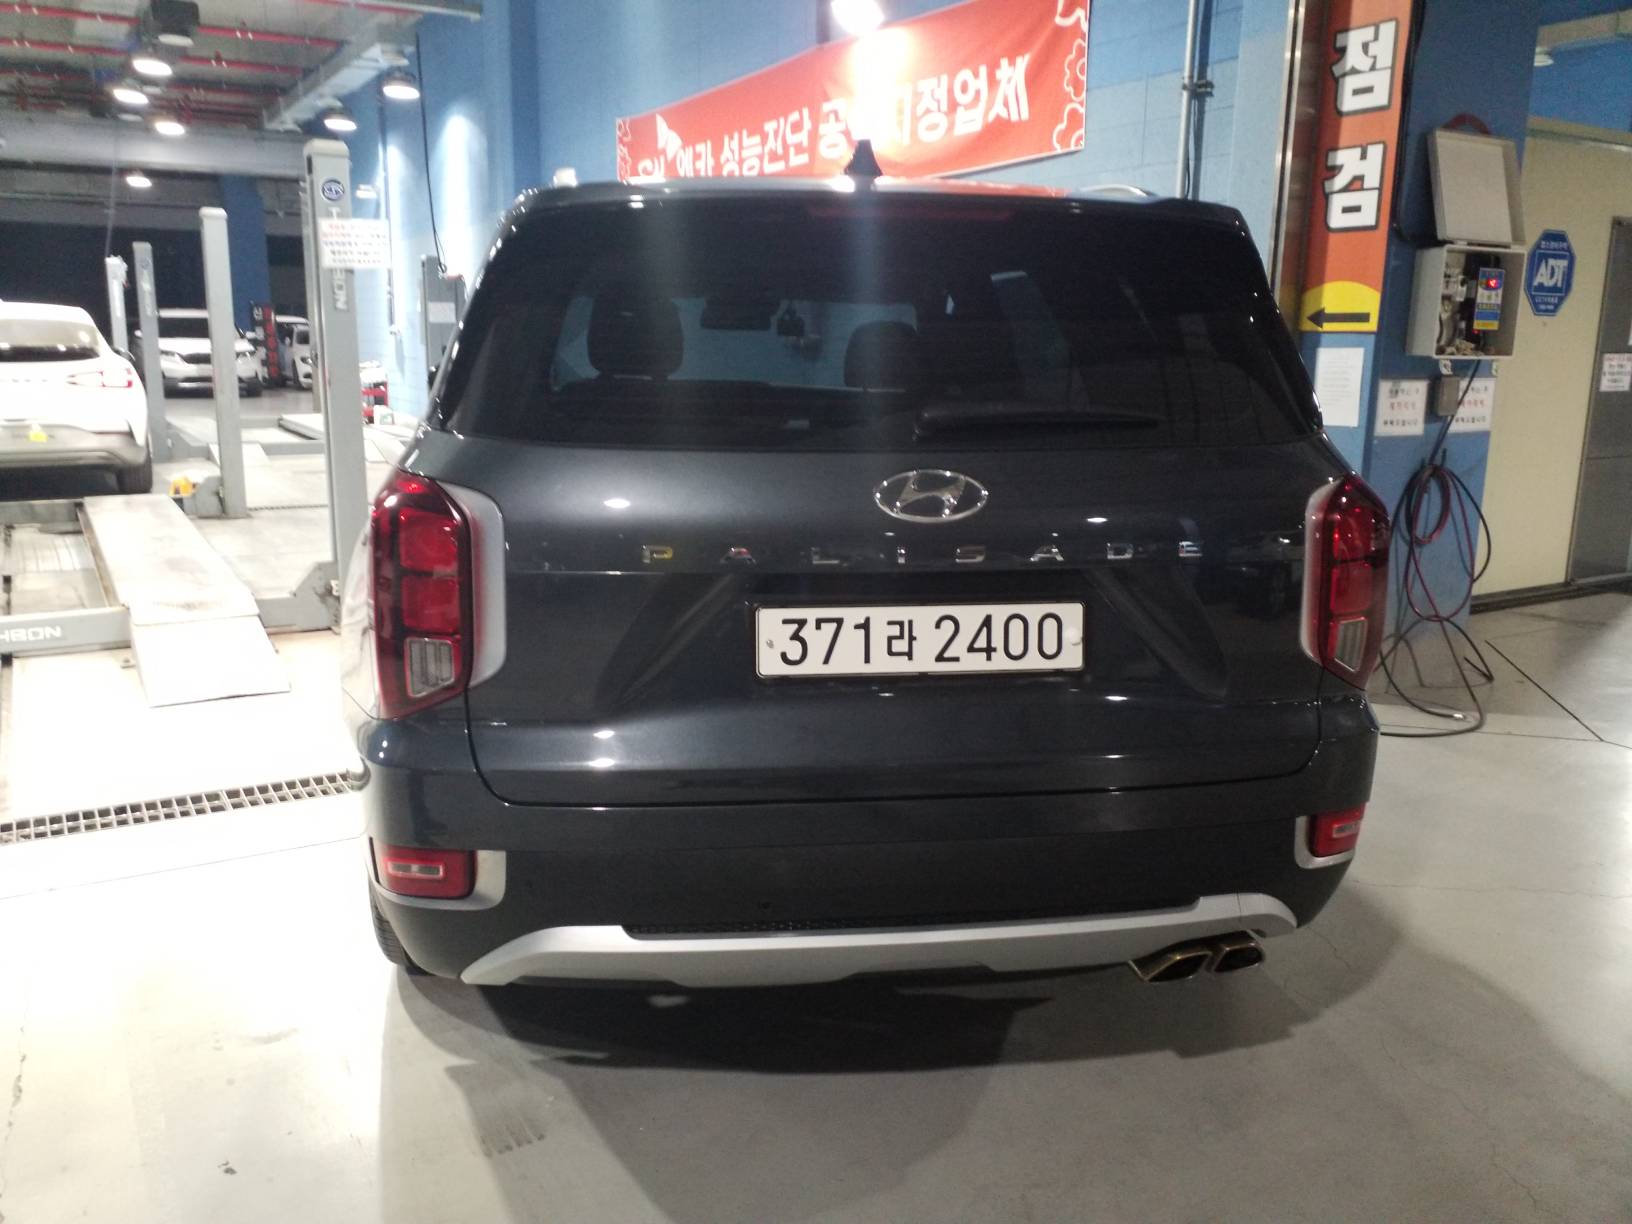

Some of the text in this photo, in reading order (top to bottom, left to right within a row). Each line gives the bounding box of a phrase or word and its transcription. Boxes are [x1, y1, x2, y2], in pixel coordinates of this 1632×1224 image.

[719, 106, 812, 177] 성능진단
[1324, 18, 1398, 232] 점검
[1533, 257, 1569, 288] ADT
[641, 541, 1203, 565] PALISADE
[779, 612, 1063, 666] 371라 2400
